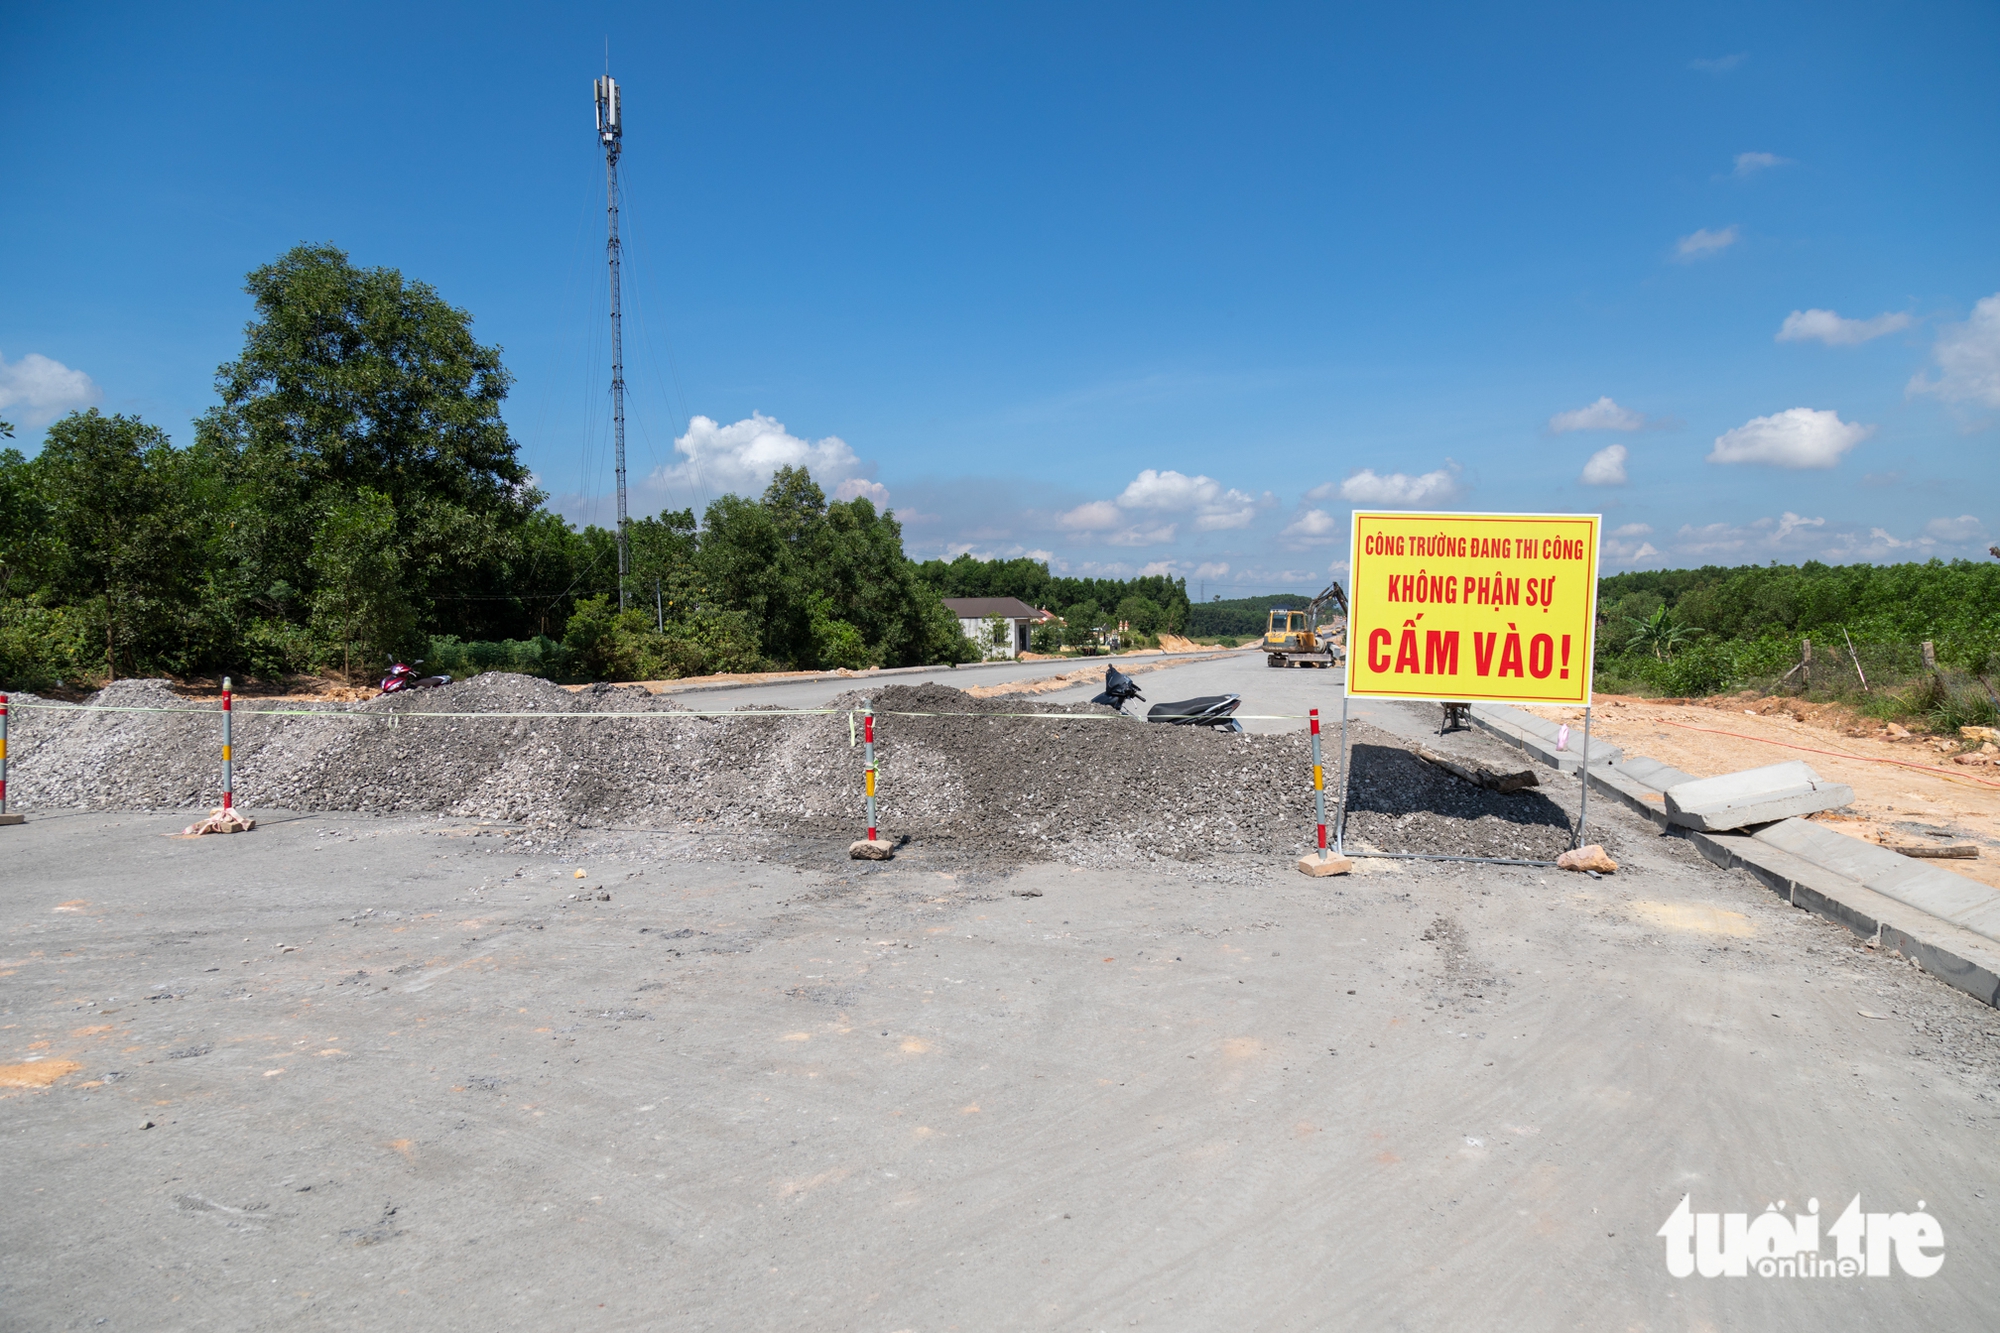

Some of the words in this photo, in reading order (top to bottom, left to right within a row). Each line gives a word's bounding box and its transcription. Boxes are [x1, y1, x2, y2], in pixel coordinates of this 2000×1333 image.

[1365, 531, 1405, 557] CÔNG
[1409, 532, 1467, 558] TRƯỜNG
[1470, 538, 1511, 559] ĐANG
[1515, 539, 1539, 560] THI
[1542, 535, 1584, 561] CÔNG
[1388, 569, 1458, 605] KHÔNG
[1463, 571, 1520, 612] PHẬN
[1526, 575, 1556, 613] SỰ
[1367, 613, 1460, 675] CẤM
[1474, 622, 1571, 680] VÀO!
